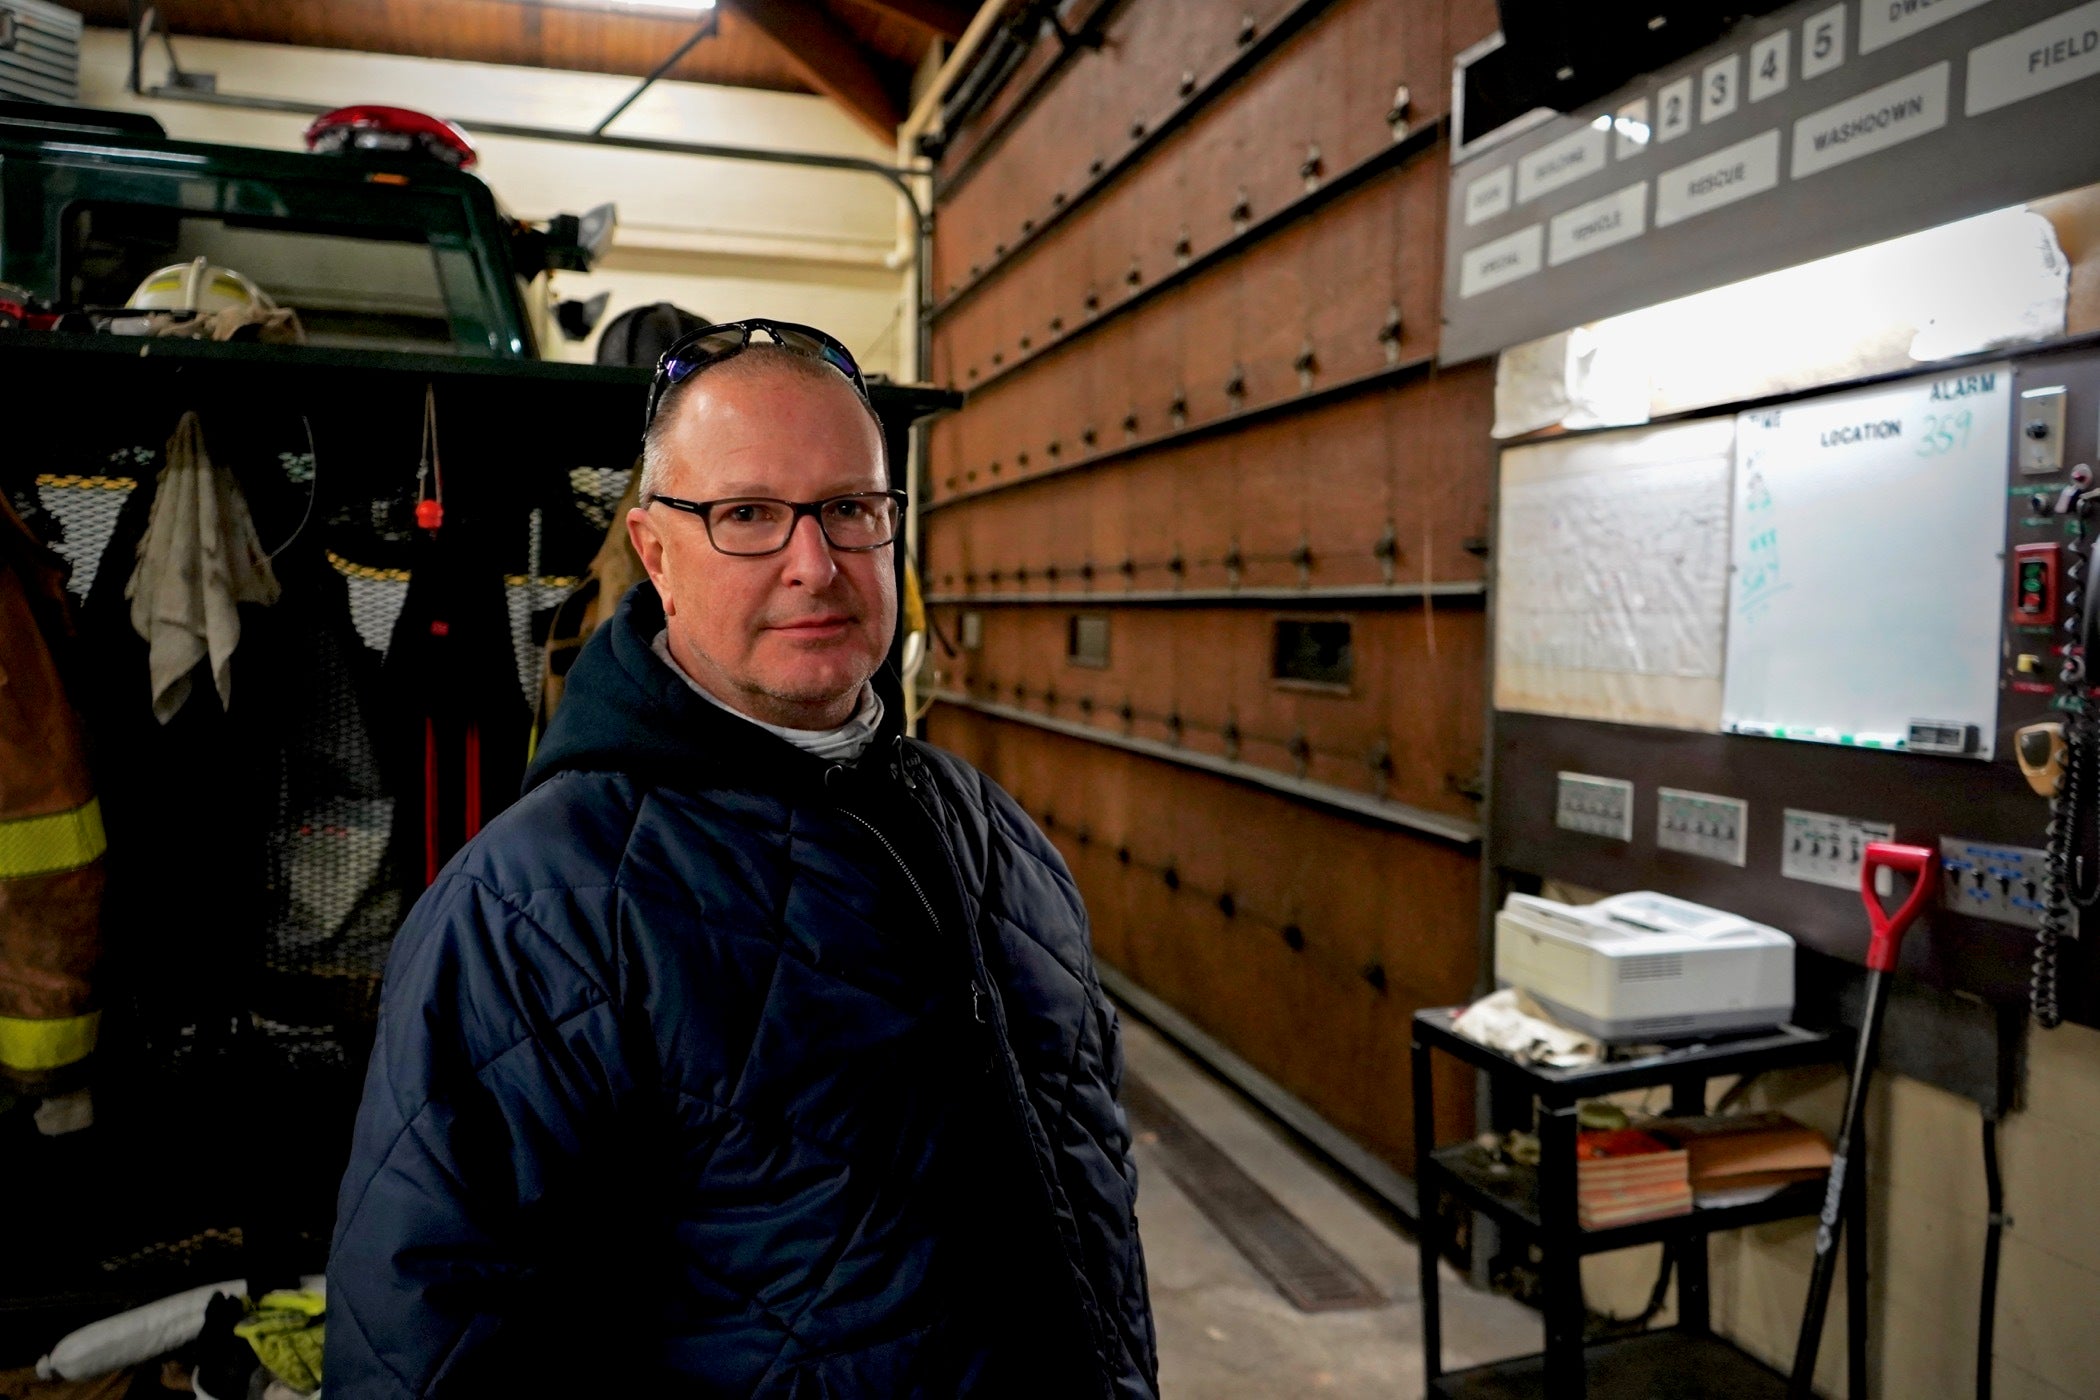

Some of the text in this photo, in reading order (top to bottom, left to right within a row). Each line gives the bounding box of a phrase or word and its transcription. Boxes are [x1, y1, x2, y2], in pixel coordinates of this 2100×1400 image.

[1813, 23, 1831, 58] 5
[2028, 29, 2099, 73] FIELD
[1760, 48, 1777, 80] 4
[1711, 72, 1727, 105] 3
[1665, 95, 1681, 127] 2
[1813, 96, 1924, 151] WASHDOWN
[1687, 162, 1745, 196] RESCUE
[1929, 372, 1997, 403] ALARM
[1820, 420, 1902, 447] LOCATION
